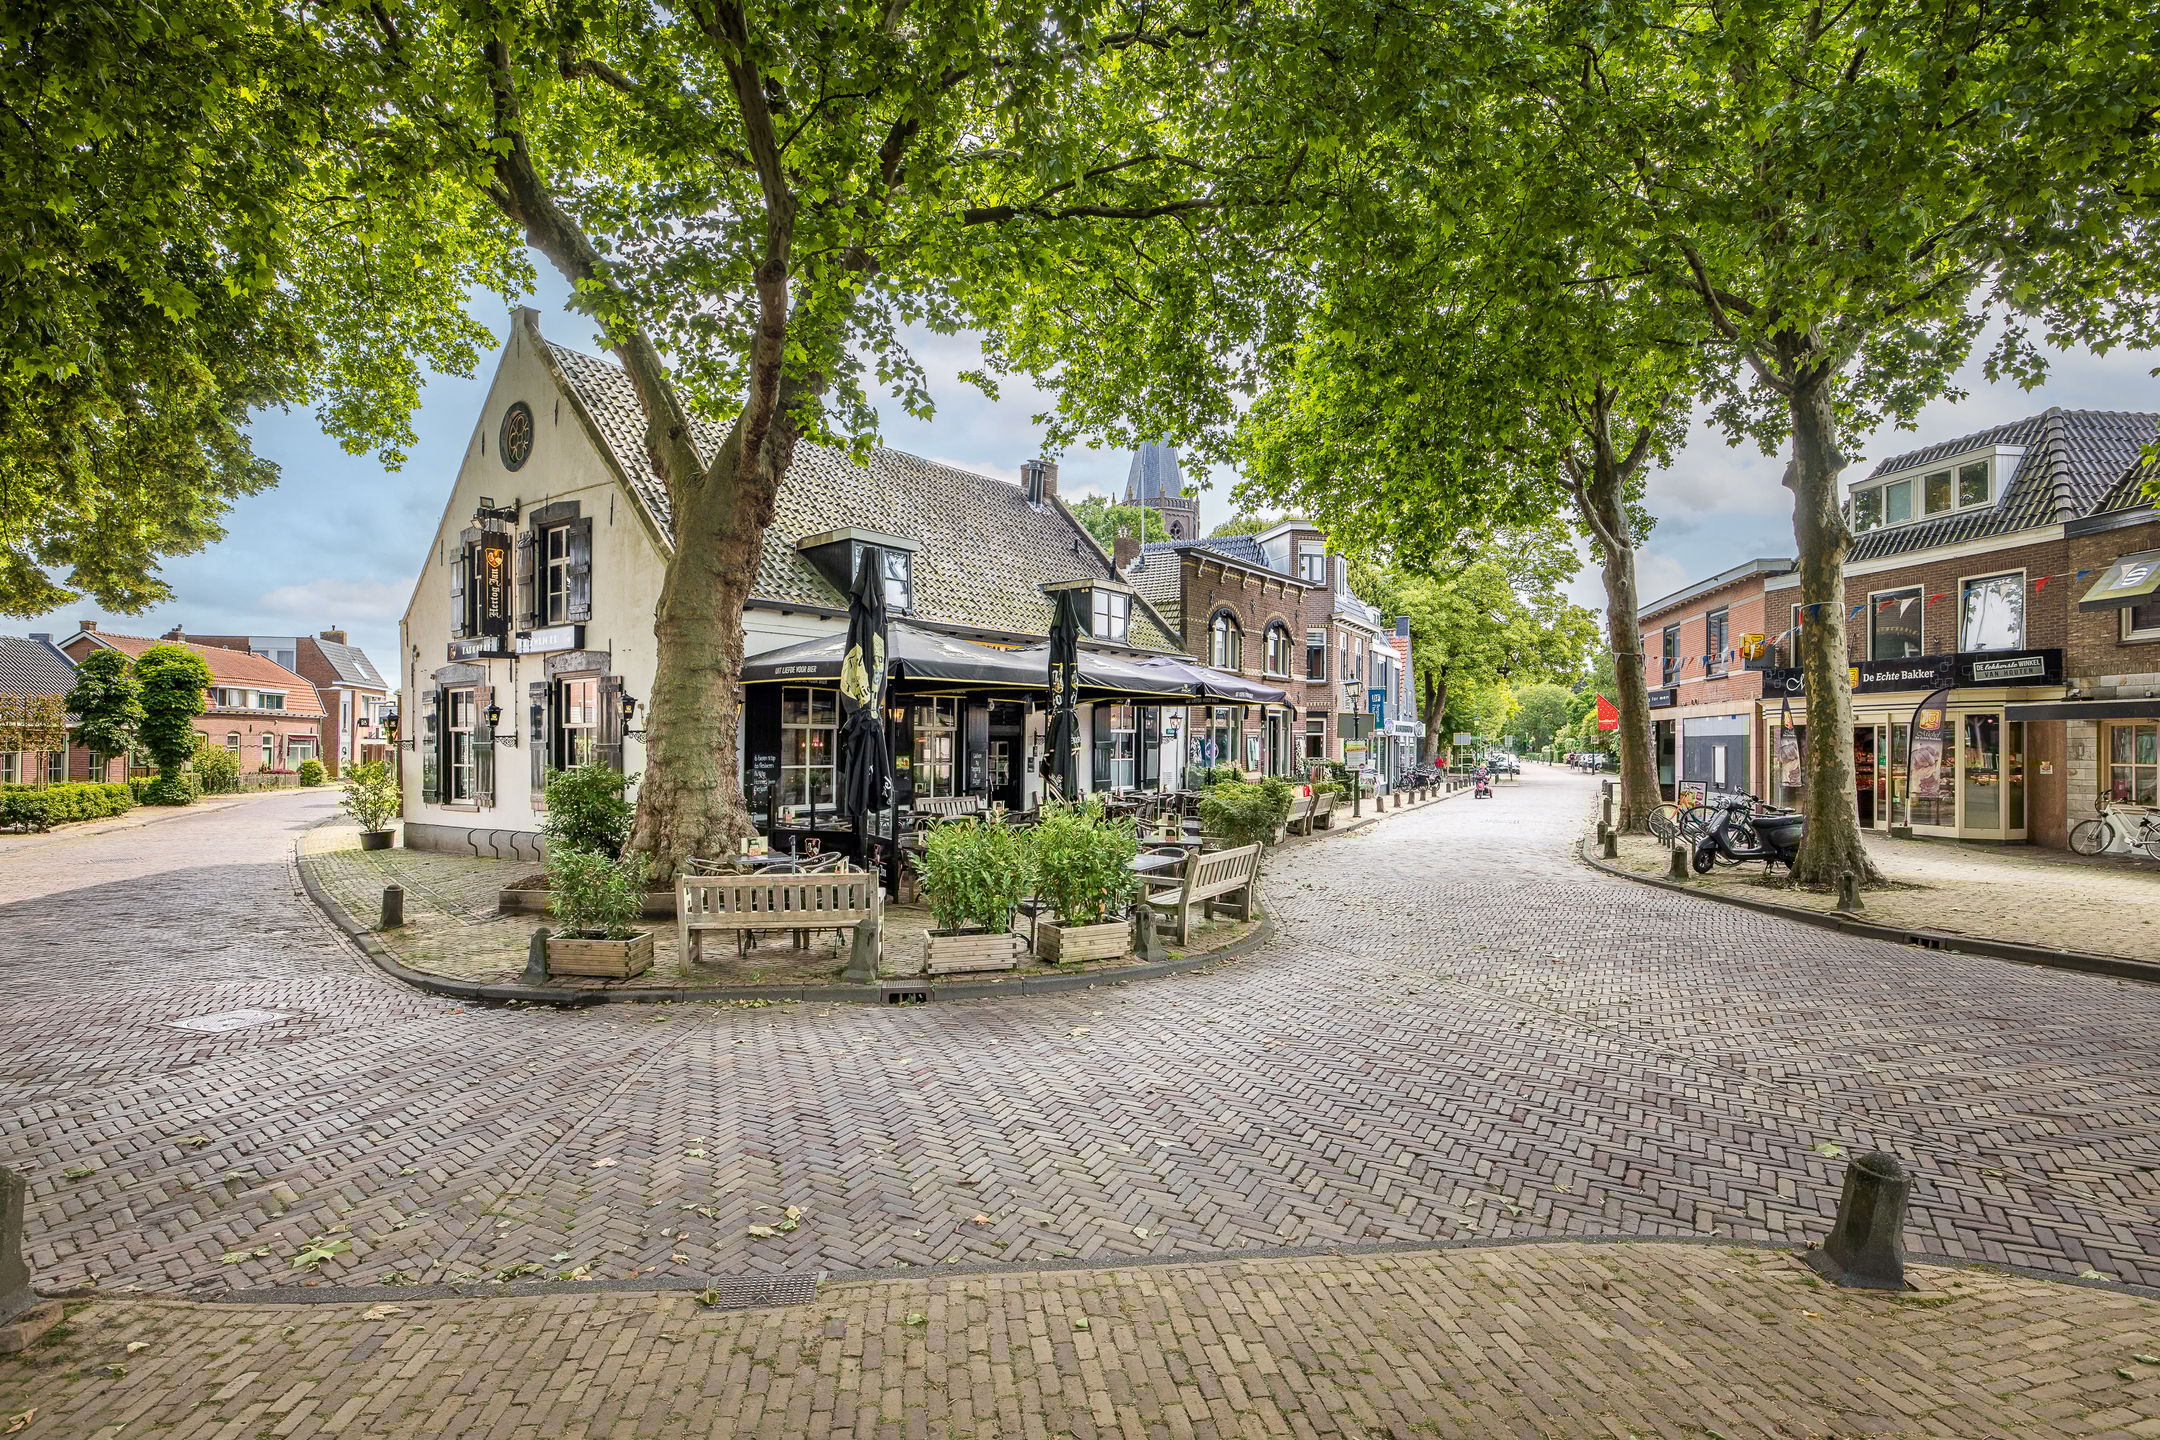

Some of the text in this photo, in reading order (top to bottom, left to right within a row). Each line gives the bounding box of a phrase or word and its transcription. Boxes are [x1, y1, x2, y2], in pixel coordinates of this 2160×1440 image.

[489, 568, 501, 619] Hertog Jan
[1985, 661, 2018, 670] lekkerste
[2018, 659, 2040, 667] WINKEL
[1863, 669, 1934, 682] De Echte Bakker
[2004, 667, 2033, 675] HOUTEN
